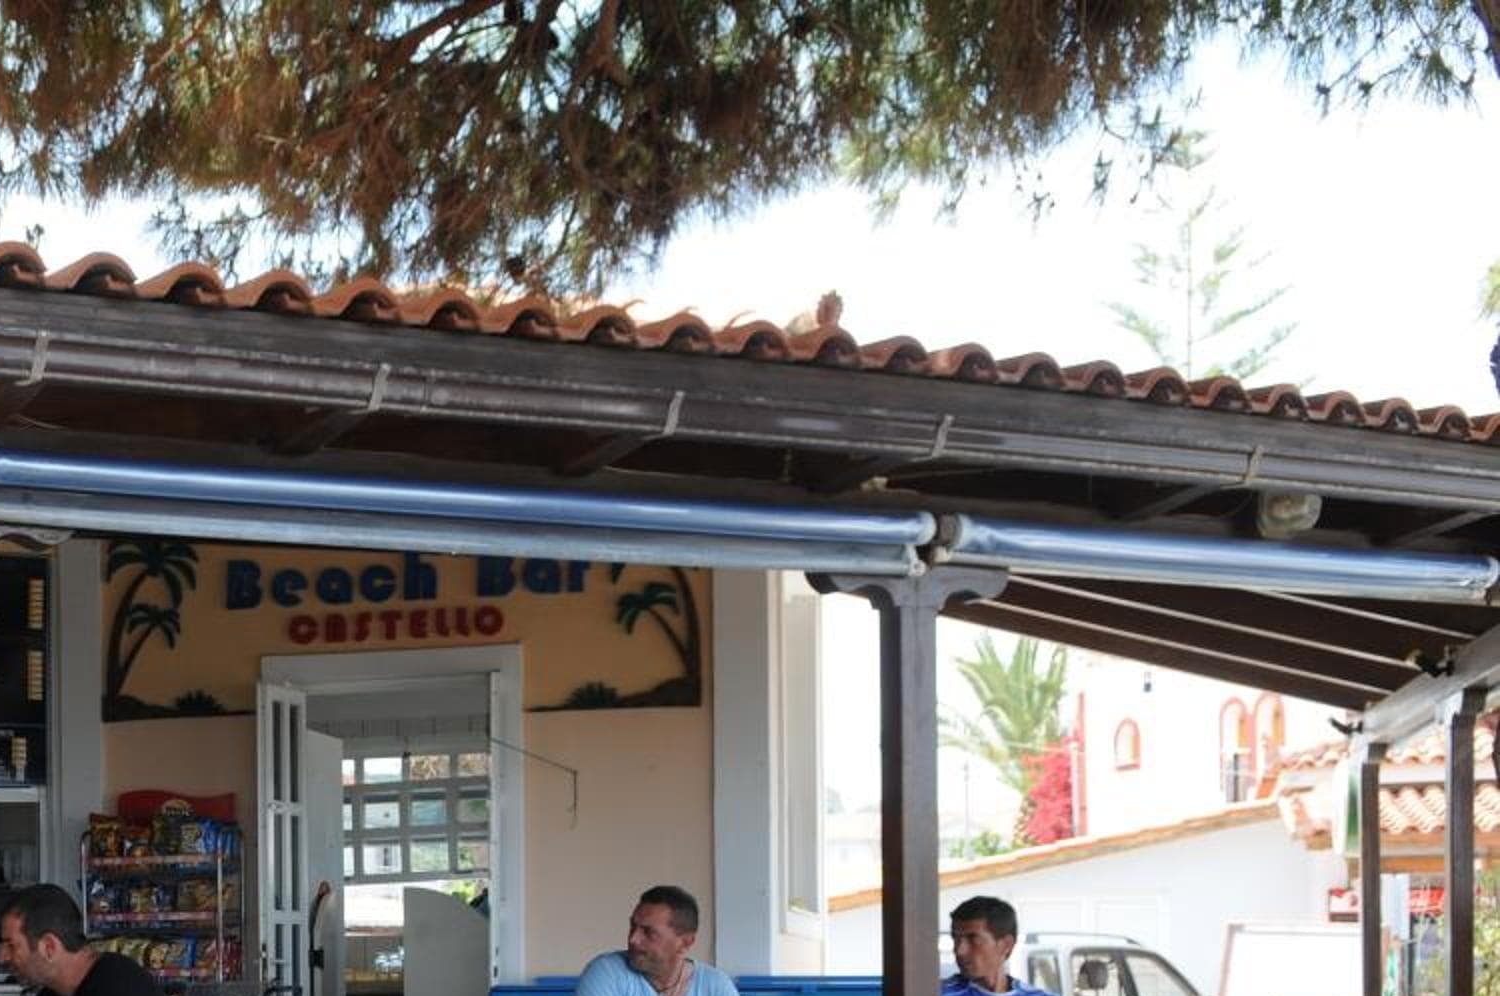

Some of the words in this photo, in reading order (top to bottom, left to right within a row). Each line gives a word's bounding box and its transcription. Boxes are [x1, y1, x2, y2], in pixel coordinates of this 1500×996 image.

[225, 551, 438, 611] Beach
[475, 553, 590, 599] Bar
[287, 605, 505, 646] CASTELLO
